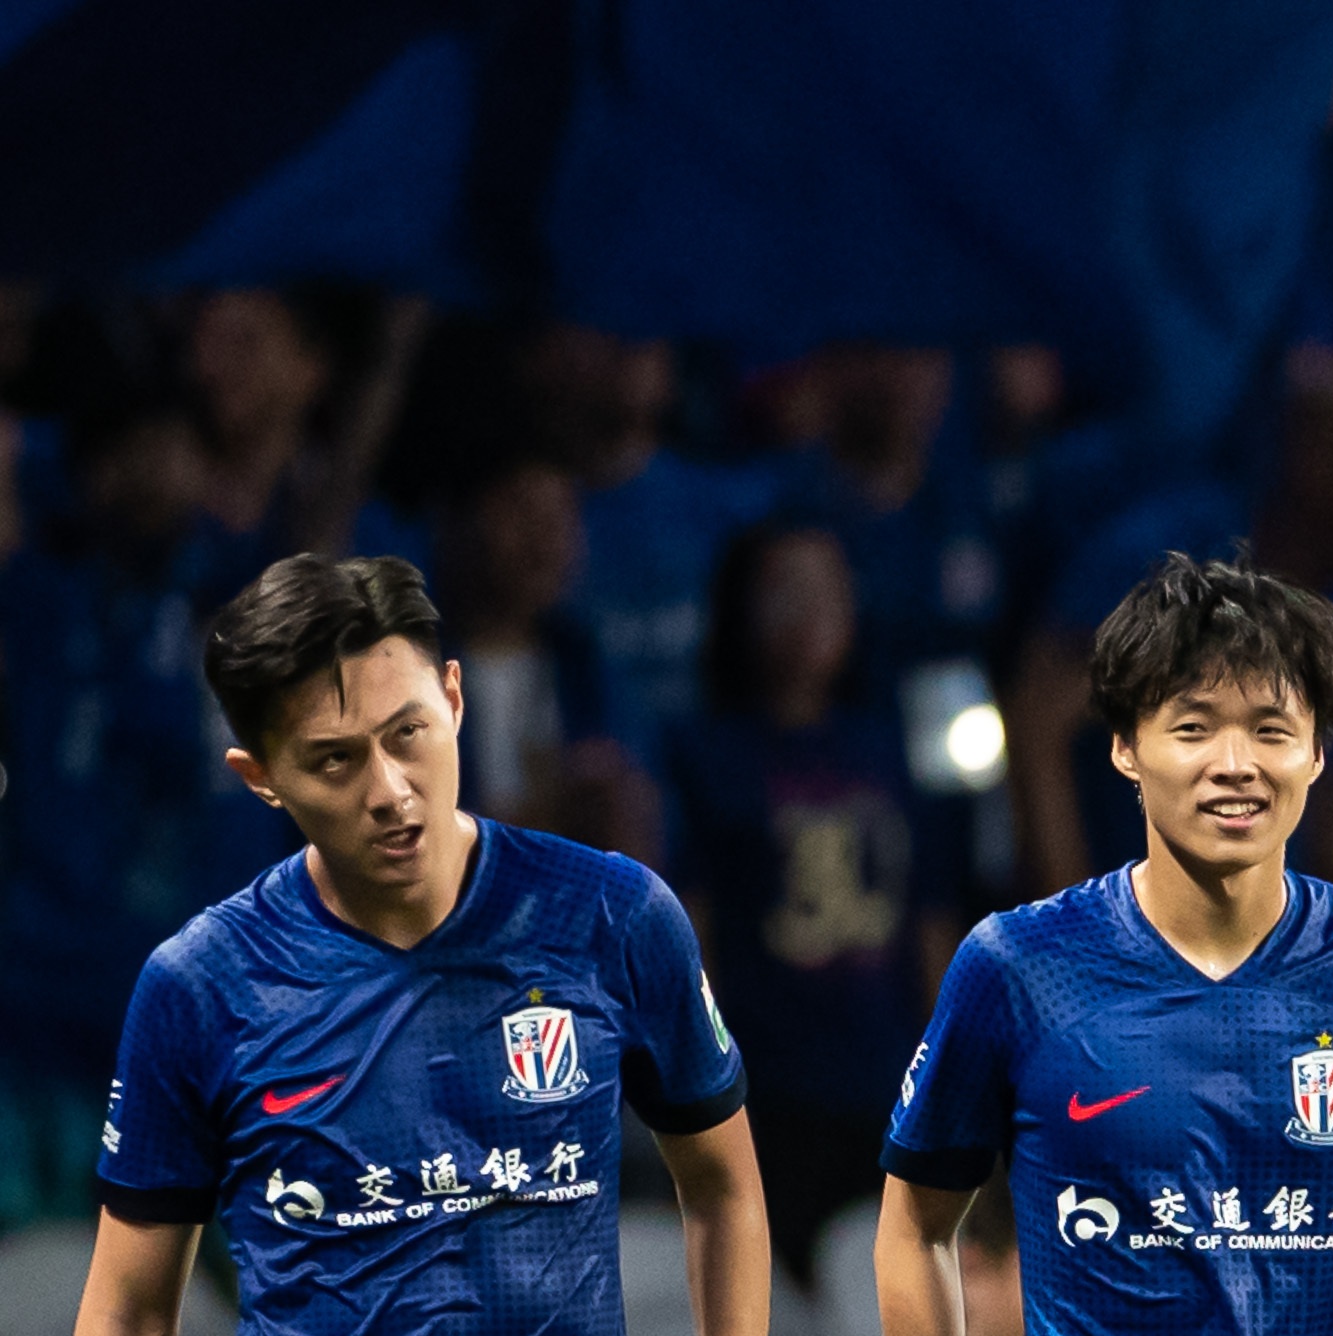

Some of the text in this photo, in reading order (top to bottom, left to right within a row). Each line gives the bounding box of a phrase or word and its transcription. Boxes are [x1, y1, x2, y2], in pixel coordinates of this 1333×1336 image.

[356, 1141, 585, 1207] 交通銀行
[337, 1210, 397, 1227] BANK
[406, 1202, 435, 1219] OF
[1129, 1234, 1185, 1250] BANK
[1195, 1233, 1222, 1250] OF
